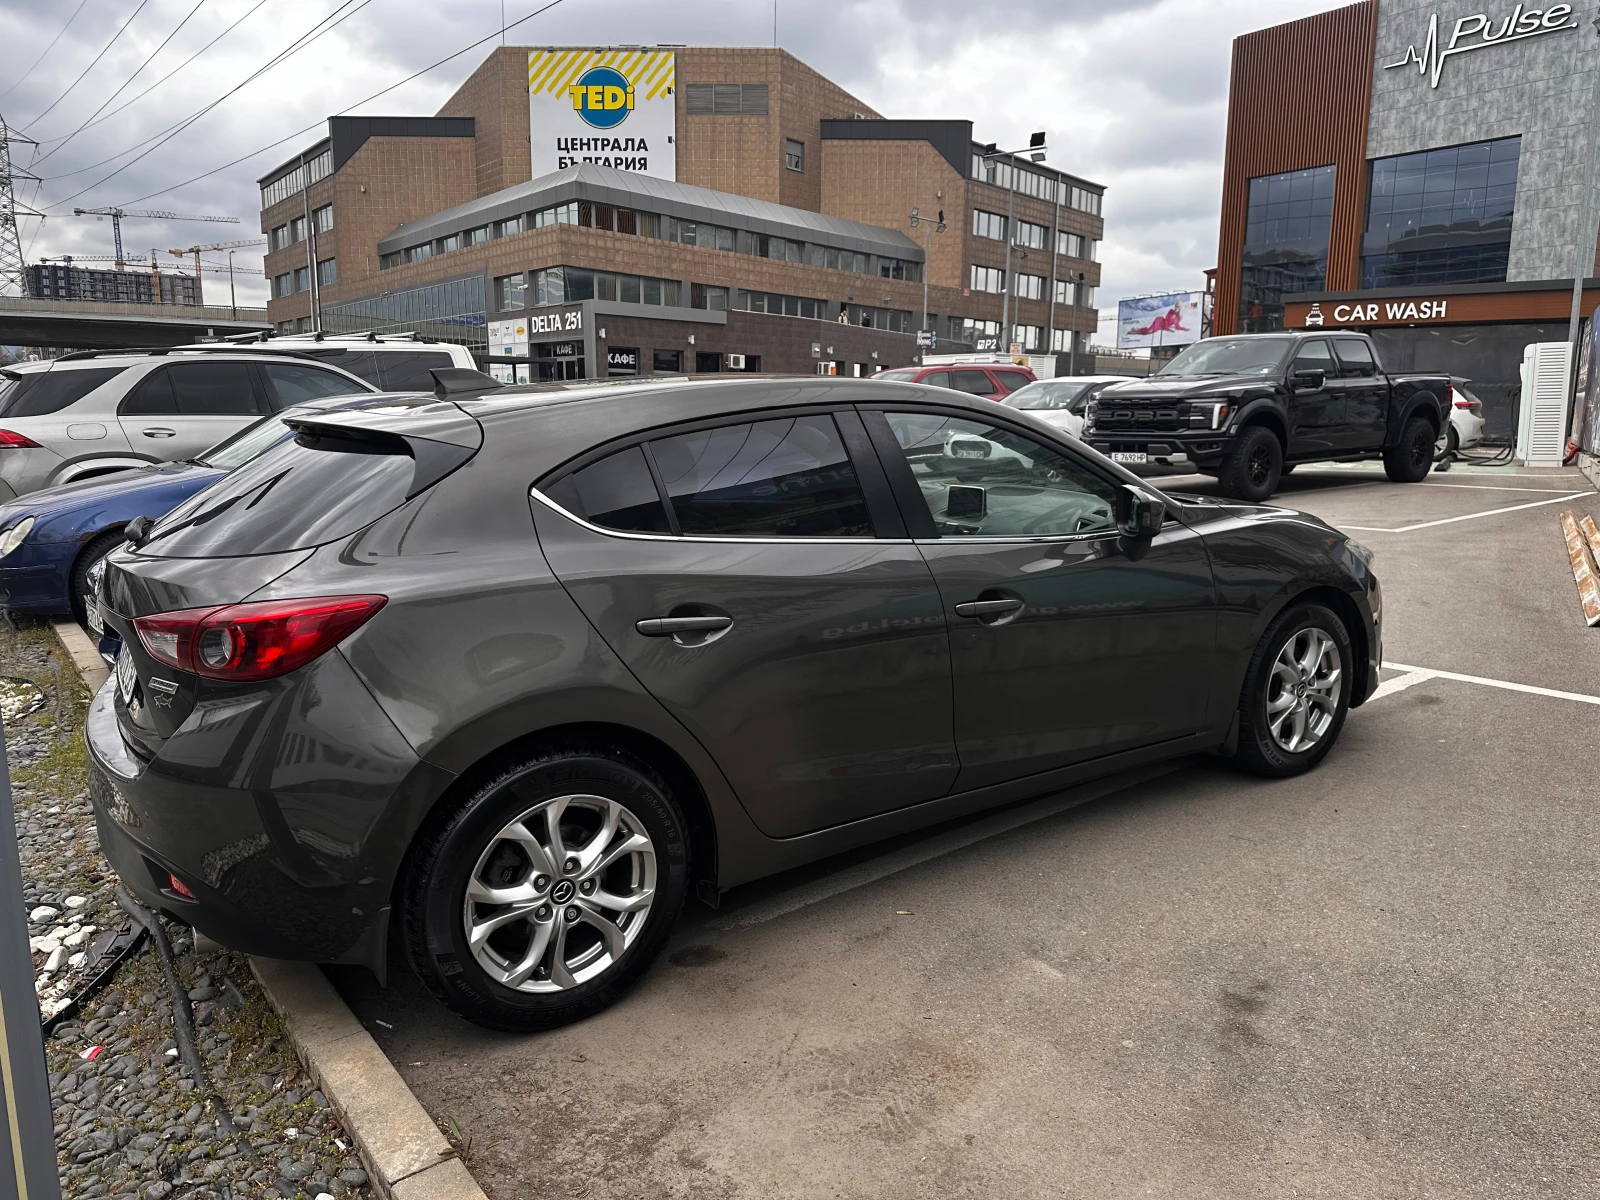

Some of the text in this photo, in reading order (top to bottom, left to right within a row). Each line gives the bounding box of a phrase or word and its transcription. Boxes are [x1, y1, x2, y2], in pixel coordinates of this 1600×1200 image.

[1448, 4, 1571, 49] Pulse
[569, 85, 635, 110] TEDi
[557, 138, 648, 153] ЦЕНТРАЛА
[532, 314, 562, 333] DELTA
[565, 311, 582, 330] 251
[1334, 301, 1447, 322] CAR WASH
[556, 344, 573, 355] КАФЕ
[984, 339, 997, 349] P2
[608, 353, 636, 365] КАФЕ
[642, 791, 676, 838] 205/60 R 16
